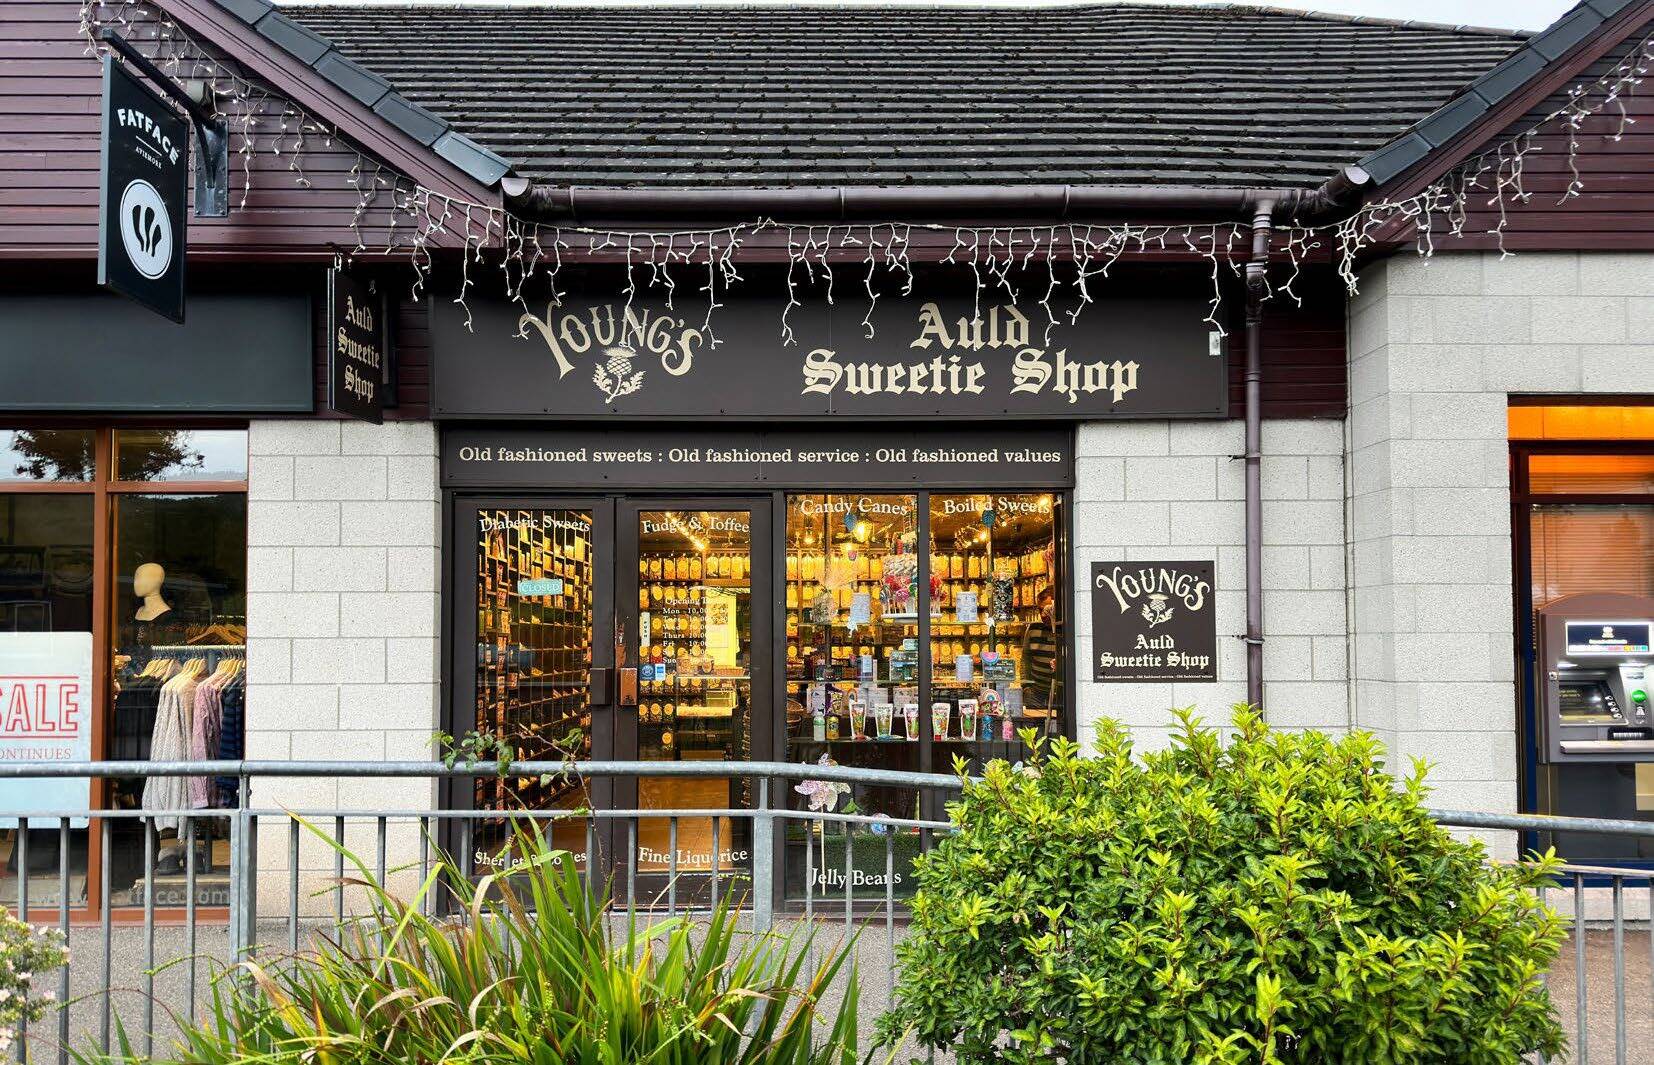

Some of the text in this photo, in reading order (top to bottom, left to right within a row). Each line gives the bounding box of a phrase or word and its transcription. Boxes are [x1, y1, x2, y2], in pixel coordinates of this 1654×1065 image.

[117, 108, 179, 166] FATFACE
[345, 295, 373, 331] Auld
[910, 302, 1030, 350] Auld
[338, 326, 380, 369] Sweetie
[344, 364, 374, 403] Shop
[801, 348, 1140, 403] Sweetie Shop
[459, 447, 492, 462] Old
[497, 447, 588, 462] fashioned
[592, 448, 653, 463] sweets
[668, 448, 700, 463] Old
[705, 449, 793, 463] fashioned
[797, 449, 860, 463] service
[875, 449, 906, 463] Old
[911, 449, 999, 463] fashioned
[1004, 449, 1061, 463] values
[801, 497, 909, 516] Candy Canes
[943, 496, 1050, 515] Boiled Sweets
[478, 515, 591, 533] Diabetic Sweets
[642, 517, 750, 535] Fudge & Toffee
[1096, 566, 1210, 614] YOUNG'S
[1134, 633, 1175, 649] Auld
[1100, 650, 1210, 670] Sweetie Shop
[0, 684, 79, 731] ALE
[473, 850, 527, 867] Sheret
[638, 846, 671, 864] Fine
[811, 867, 847, 889] Jelly
